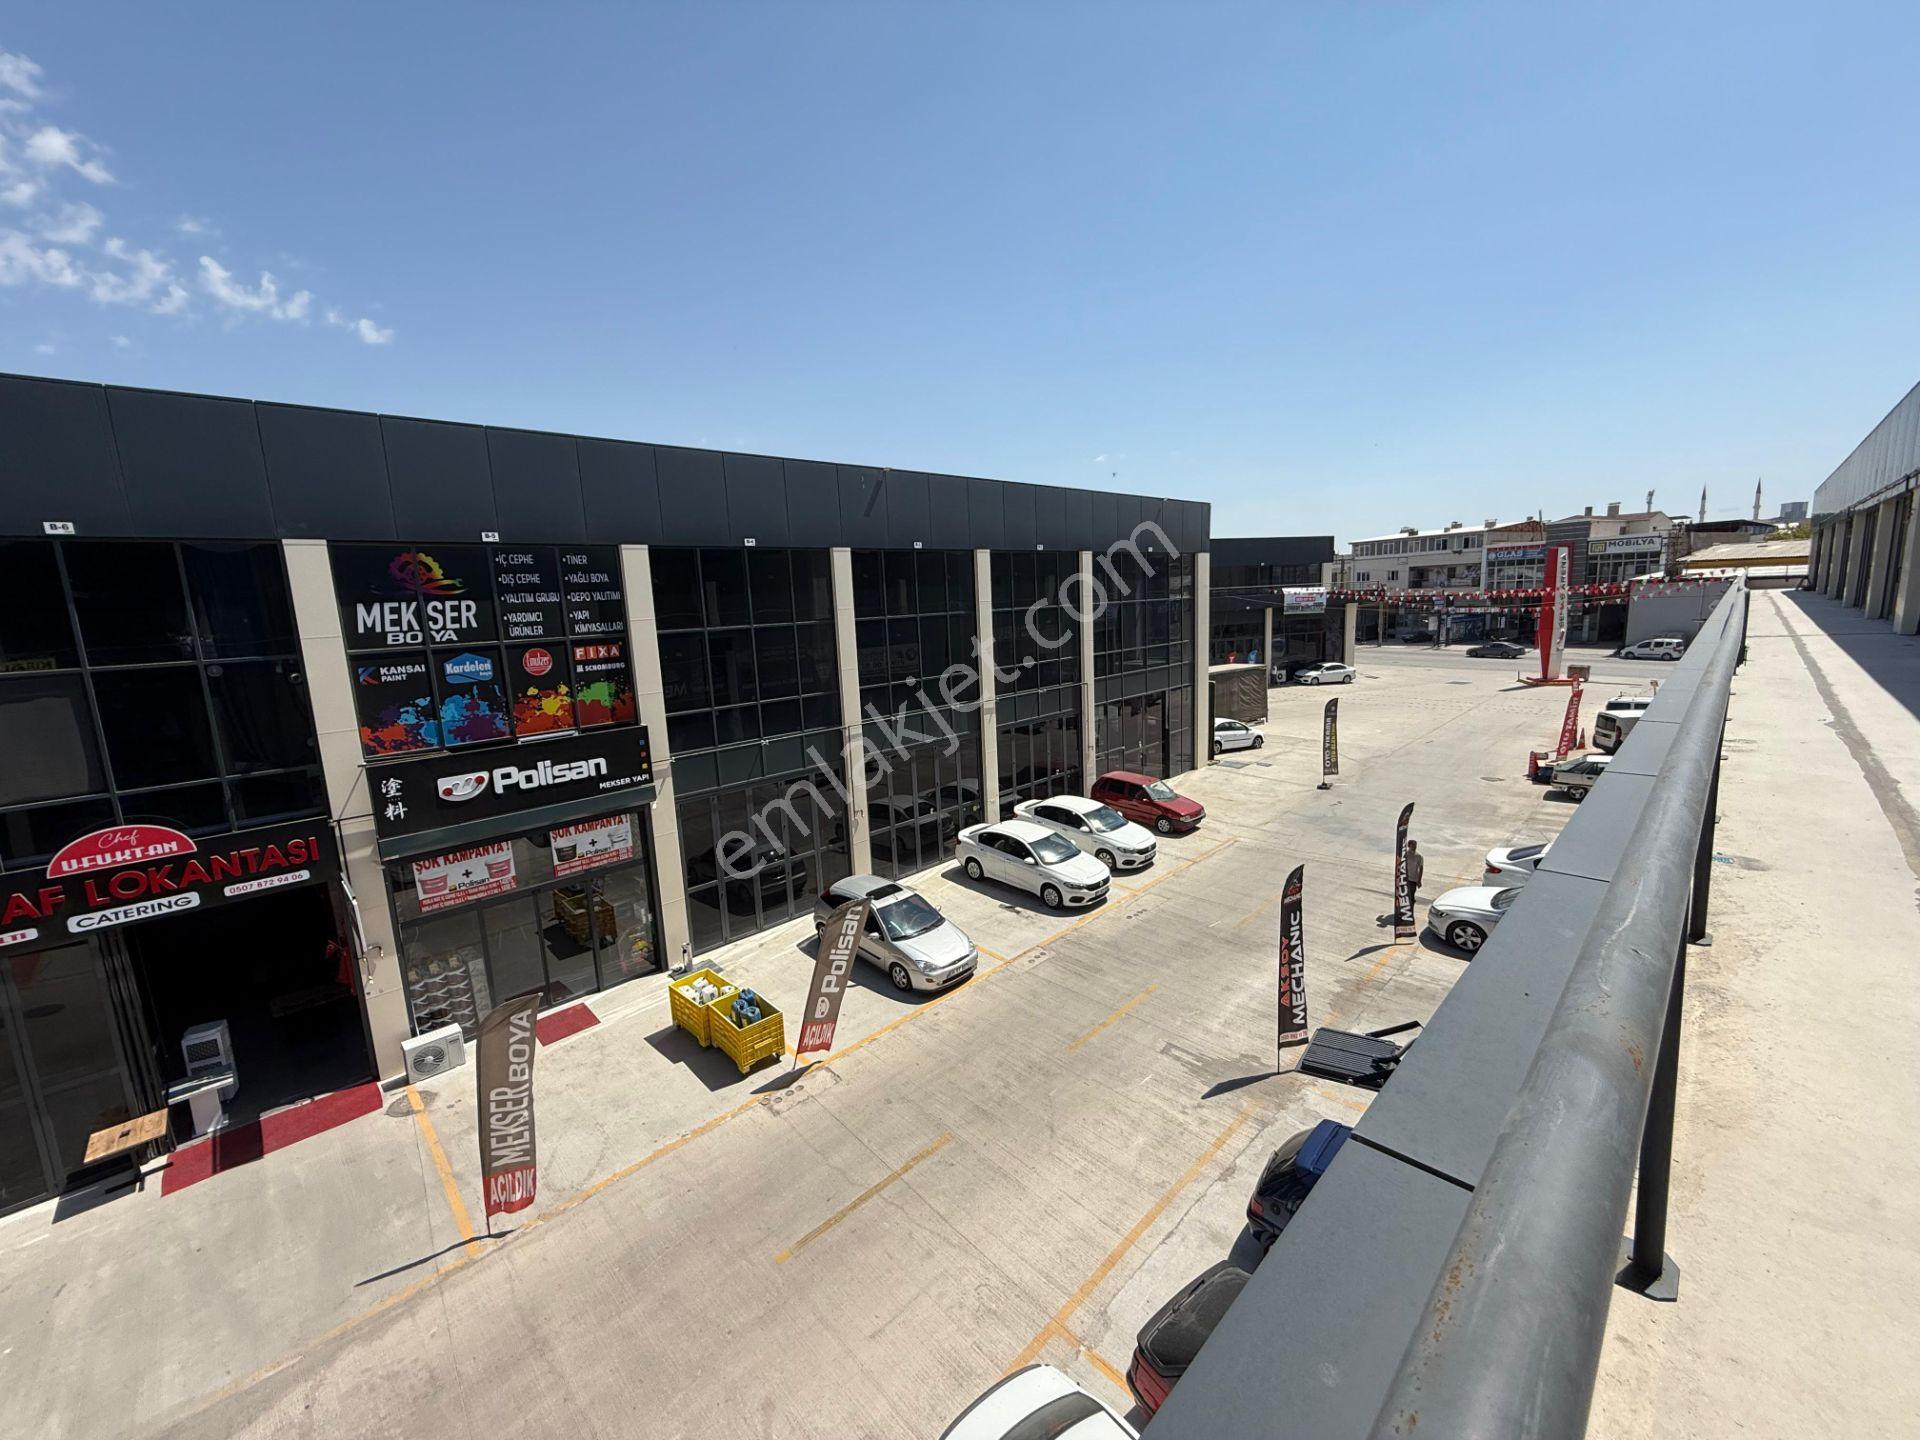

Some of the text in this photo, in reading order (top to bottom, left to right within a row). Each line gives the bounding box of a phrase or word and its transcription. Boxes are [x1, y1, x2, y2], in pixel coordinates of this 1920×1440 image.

[49, 523, 70, 531] B-6
[498, 552, 534, 567] İÇ CEPHE
[516, 573, 540, 584] CEPHE
[568, 571, 609, 583] YAĞLI BOYA
[504, 592, 561, 603] YALITIM GRUBU
[570, 591, 621, 601] DEPO YALITIMI
[356, 599, 479, 634] MEKSER
[507, 612, 544, 623] YARDIMCI
[572, 610, 590, 620] YAPI
[508, 624, 544, 637] ÜRÜNLER
[574, 621, 623, 633] KİMYASALLARI
[386, 629, 459, 645] BOYA
[575, 646, 620, 659] FIXA
[379, 664, 426, 676] KANSAI
[446, 660, 492, 675] Kardelen
[381, 674, 407, 683] PAINT
[1559, 733, 1570, 754] OTO
[492, 757, 608, 795] Polisan
[599, 774, 650, 790] MEKSER YAPI
[552, 826, 572, 842] ŞOK
[574, 816, 623, 835] KAMPANYA
[98, 829, 140, 850] Chef
[415, 856, 441, 875] ŞOK
[443, 843, 505, 866] KAMPANYA
[586, 847, 611, 857] Polisan
[84, 837, 320, 908] LOKANTASI
[229, 872, 304, 895] 0507 872 94 06
[457, 877, 490, 890] Polisan
[76, 897, 193, 929] CATERING
[821, 905, 864, 993] Polisan
[1280, 935, 1290, 1006] AKSOY
[1289, 910, 1306, 1024] MECHANIC
[802, 1023, 835, 1051] AÇILDIK
[489, 1008, 533, 1168] MEKSER BOYA
[490, 1168, 536, 1211] AÇILDIK
